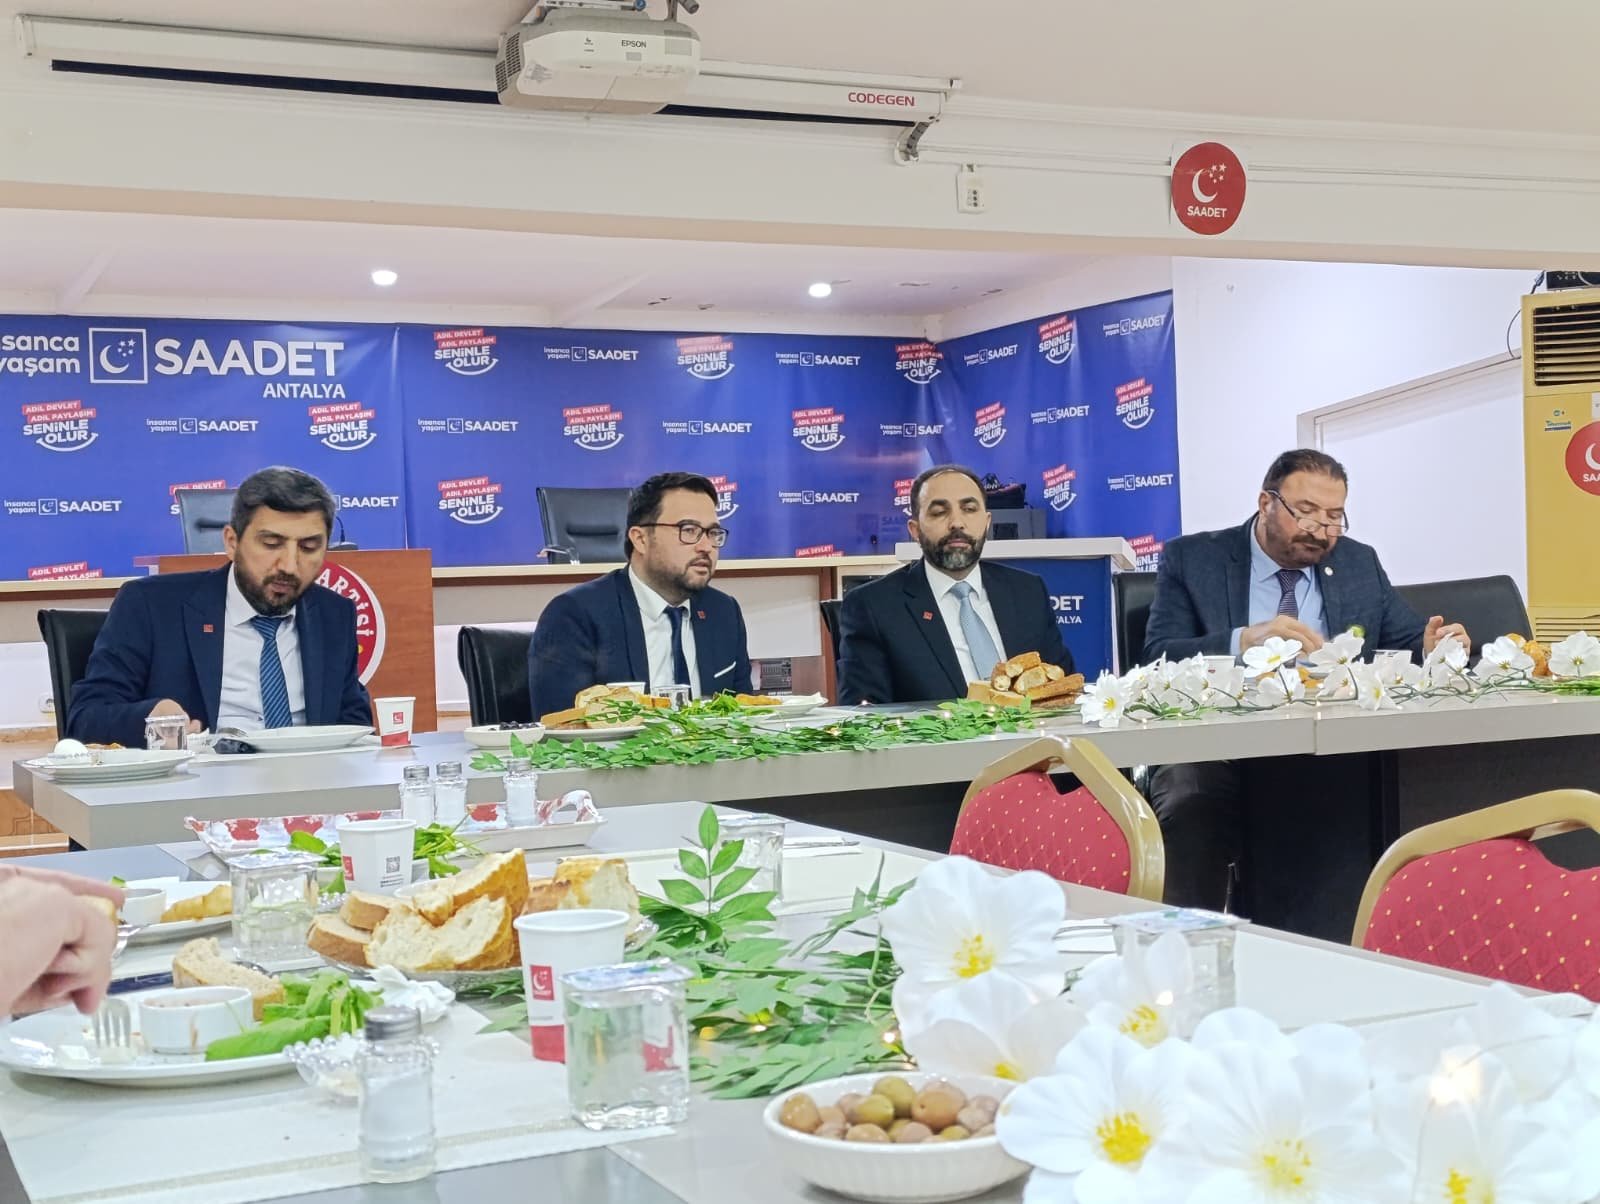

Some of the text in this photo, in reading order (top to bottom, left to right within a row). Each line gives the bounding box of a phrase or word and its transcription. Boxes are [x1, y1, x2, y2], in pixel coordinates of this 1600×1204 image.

[621, 39, 647, 48] EPSON
[848, 92, 915, 107] CODEGEN
[1187, 205, 1227, 218] SAADET
[1, 334, 80, 351] sanca
[154, 338, 345, 377] SAADET
[588, 349, 639, 361] SAADET
[988, 344, 1018, 360] SAADET
[453, 355, 490, 368] OLUR
[814, 355, 861, 366] SAADET
[694, 361, 727, 373] OLUR
[263, 383, 346, 399] ANTALYA
[46, 401, 78, 411] DEVLET
[330, 403, 358, 412] DEVLET
[1127, 407, 1149, 422] OLUR
[199, 421, 258, 432] SAADET
[465, 420, 518, 431] SAADET
[704, 422, 752, 433] SAADET
[45, 430, 88, 444] OLUR
[329, 430, 367, 444] OLUR
[581, 430, 616, 443] OLUR
[806, 433, 838, 444] OLUR
[459, 479, 486, 487] DEVLET
[1135, 474, 1173, 488] SAADET
[342, 496, 399, 508] SAADET
[815, 492, 859, 503] SAADET
[59, 501, 122, 512] SAADET
[457, 504, 494, 517] OLUR
[715, 502, 731, 511] UR
[52, 563, 85, 574] DEVLET
[1049, 595, 1084, 611] DET
[1056, 615, 1082, 624] ALYA
